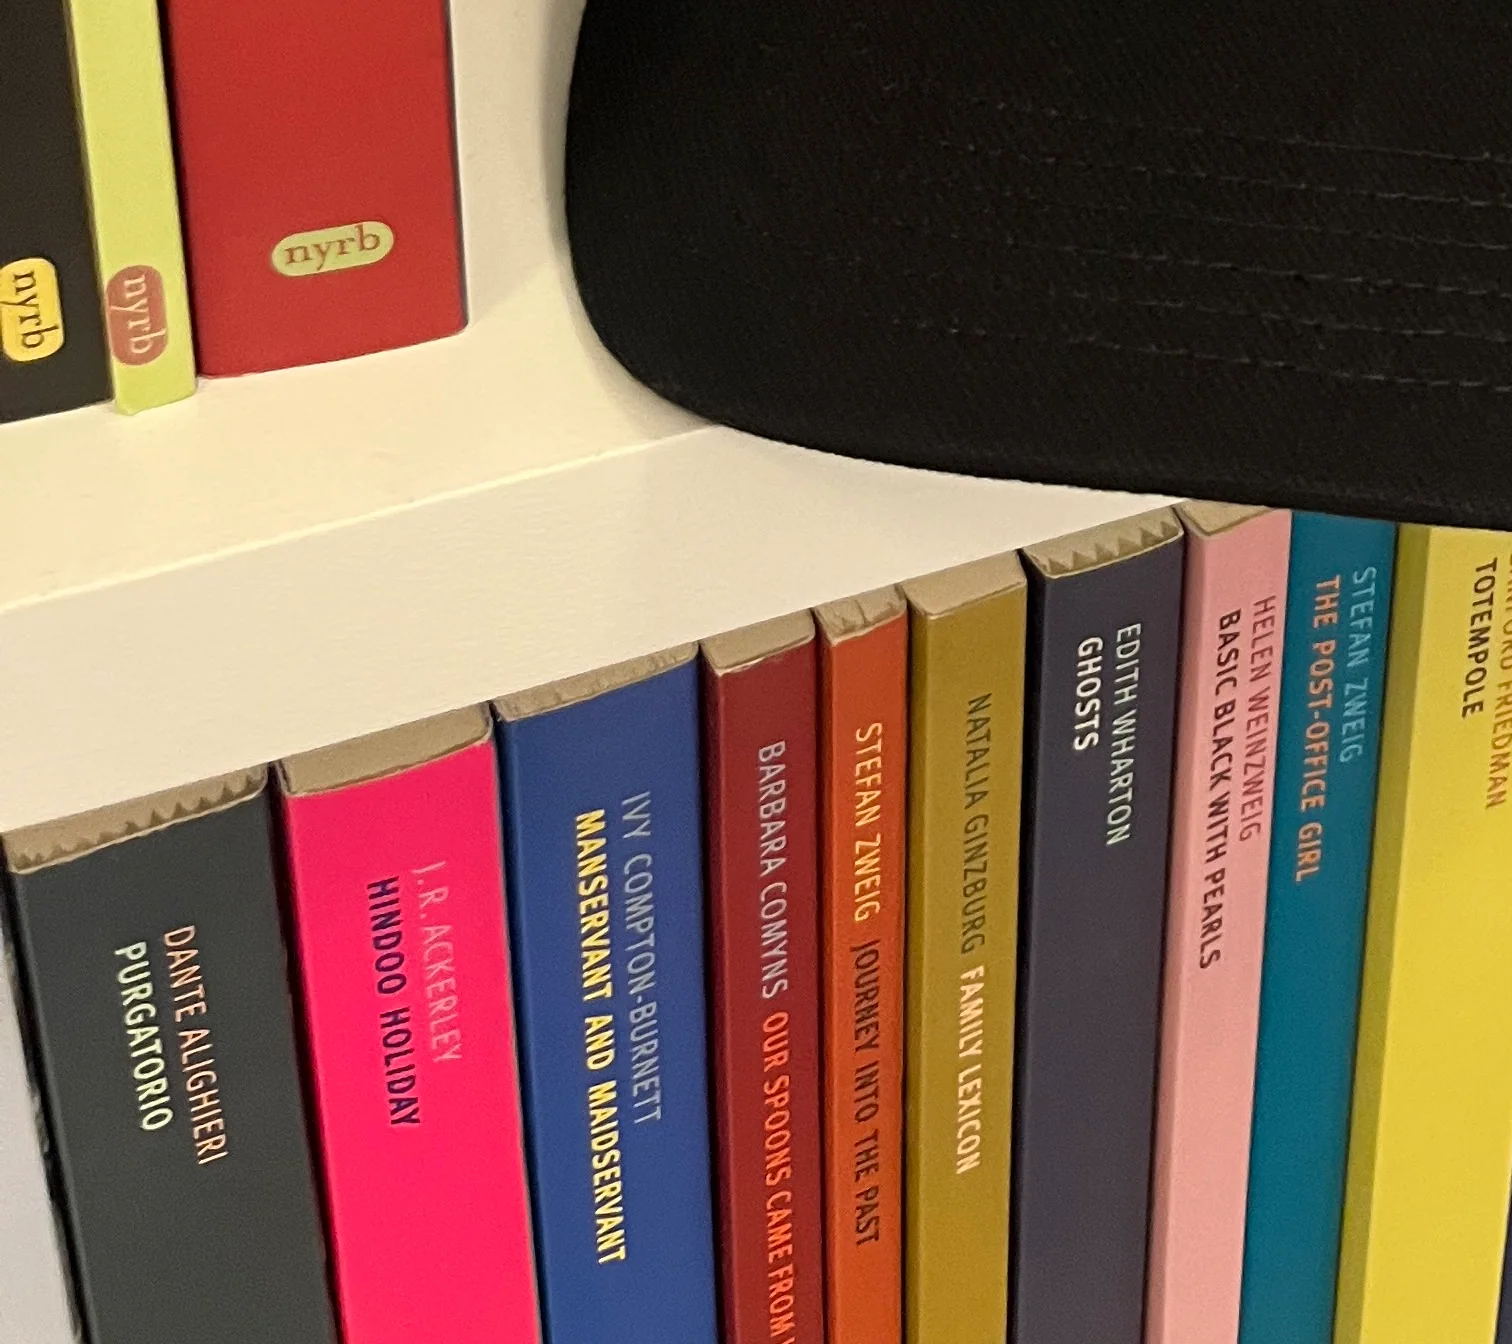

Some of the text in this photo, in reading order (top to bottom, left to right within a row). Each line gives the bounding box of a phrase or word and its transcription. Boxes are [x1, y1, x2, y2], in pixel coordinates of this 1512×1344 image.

[2, 269, 58, 348] nyrb
[109, 273, 165, 352] nyrb
[283, 223, 380, 269] nyrb
[1073, 636, 1102, 750] GHOSTS
[1105, 622, 1140, 845] EDITH WHARTON
[1238, 594, 1275, 841] HELEN WEINZWEIG
[1295, 574, 1340, 880] THE POST-OFFICE GIRL
[1338, 565, 1376, 762] STEFAN ZWEIG
[1461, 556, 1497, 718] TOTEMPOLE
[1198, 607, 1239, 968] BASIC BLACK WITH PEARLS
[114, 940, 172, 1132] PURGATORIO
[162, 923, 228, 1164] DANTE ALIGHIERI
[366, 875, 420, 1126] HINDOO HOLIDAY
[421, 923, 462, 1062] ACKERLEY
[575, 808, 625, 1263] MANSERVANT AND MAIDSERVANT
[620, 791, 662, 1123] IVY COMPTON-BURNETT
[757, 739, 795, 1334] BARBARA COMYNS OUR SPOONS CAME FROM
[849, 721, 882, 1244] STEFAN ZWEIG JOURNEY INTO THE PAST
[954, 692, 992, 1173] NATALIA GINZBURG FAMILY LEXICON
